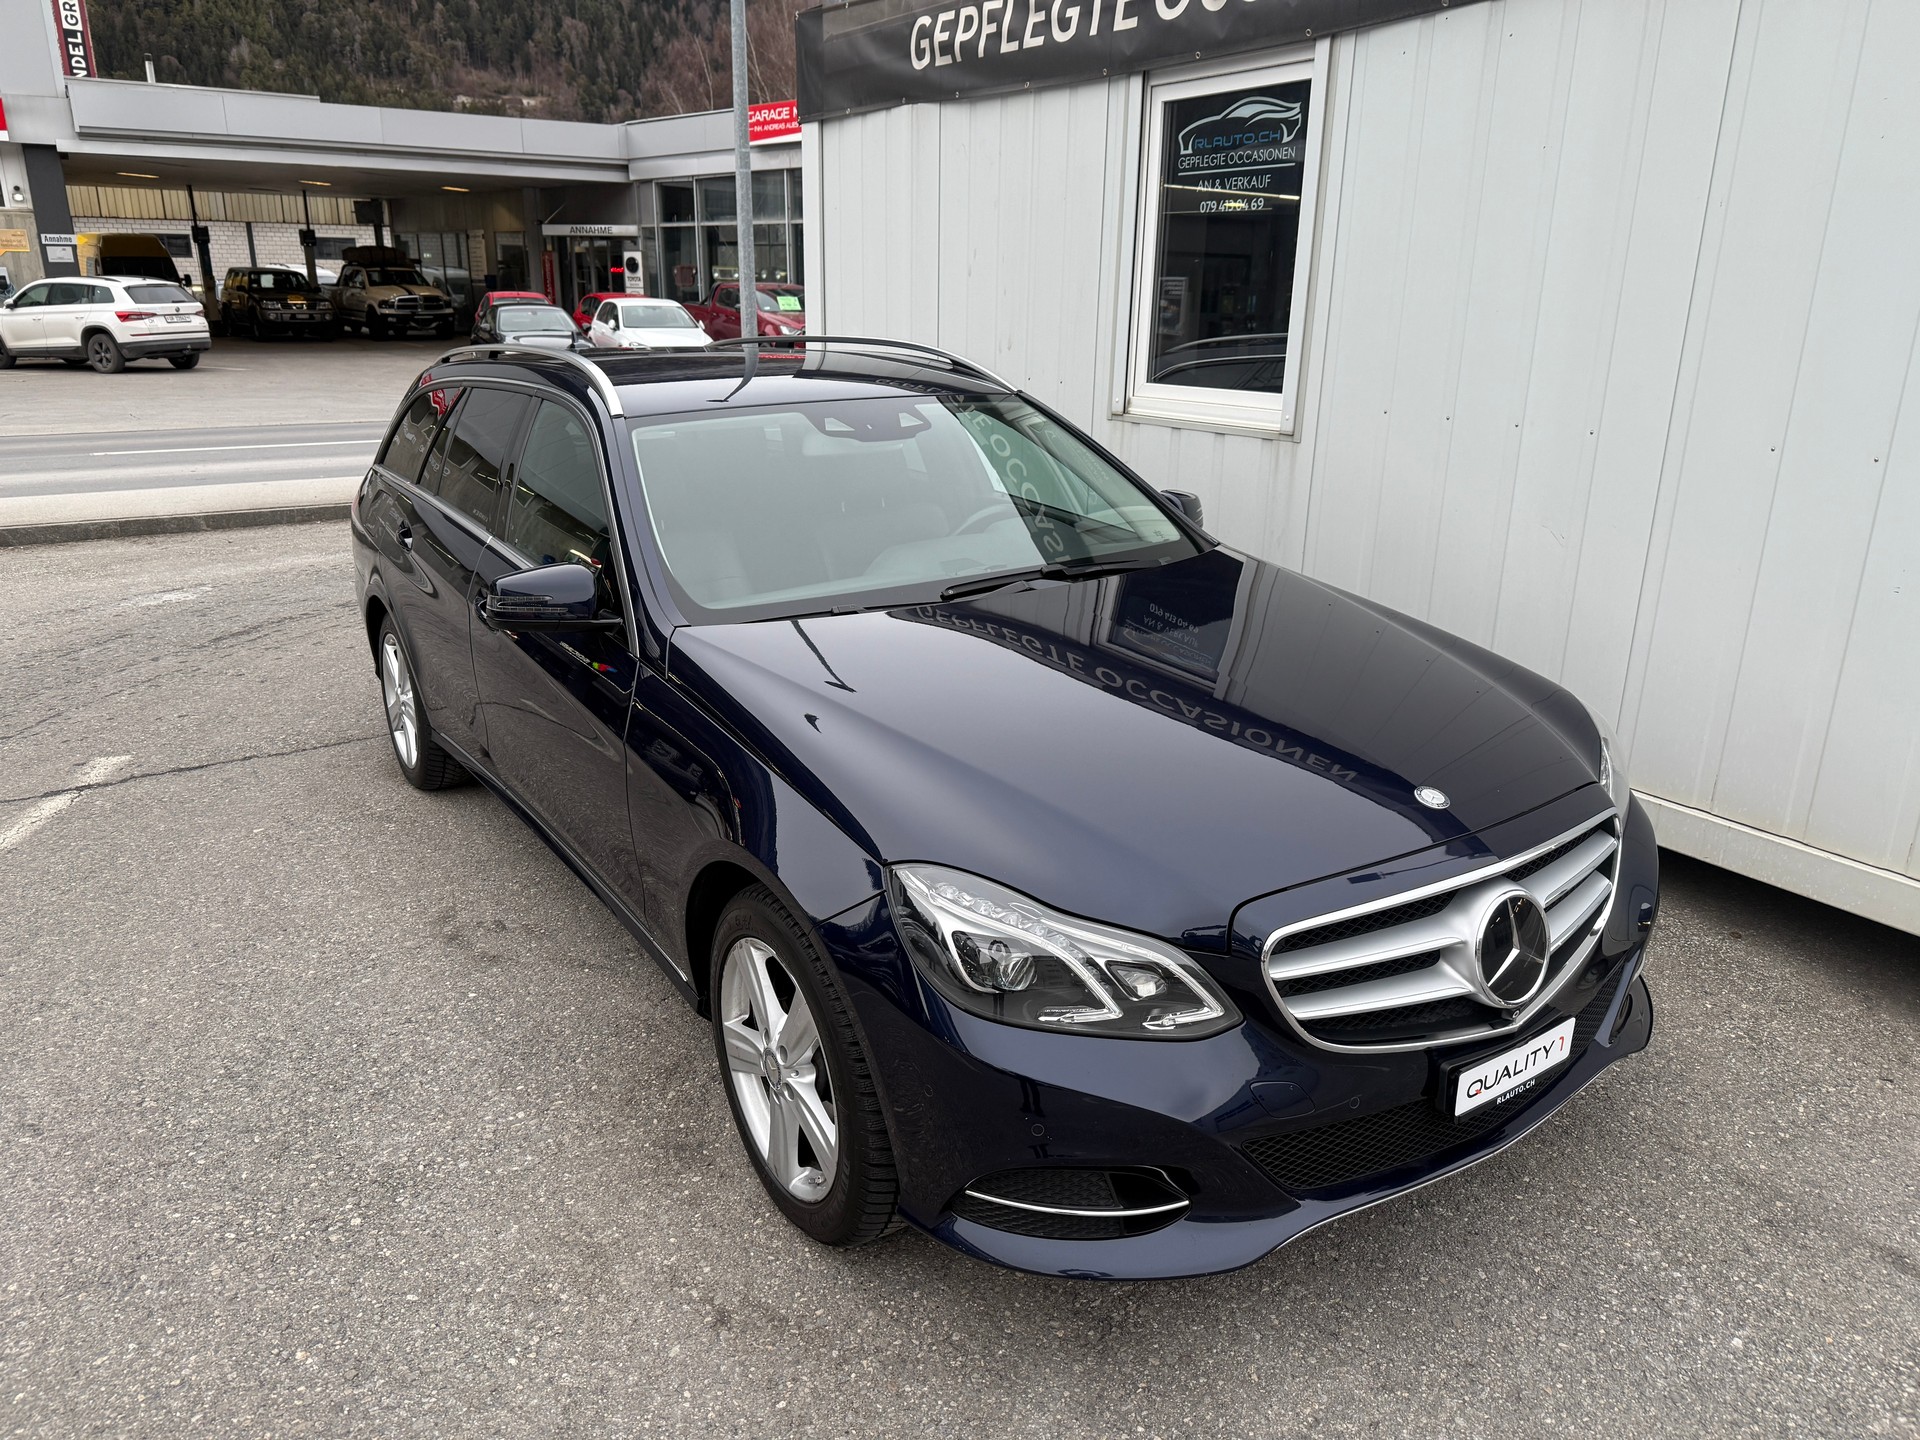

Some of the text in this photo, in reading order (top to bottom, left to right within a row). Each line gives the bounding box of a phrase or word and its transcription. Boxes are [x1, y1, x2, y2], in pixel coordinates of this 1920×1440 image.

[748, 107, 790, 122] GARAGE
[1194, 130, 1281, 149] RLAUTO.CH
[1178, 146, 1296, 169] GEPFLEGTE OCCASIONEN
[1196, 174, 1272, 192] AN & VERKAUF
[1200, 200, 1216, 214] 079
[1250, 197, 1264, 210] 69
[44, 235, 73, 243] Annahme
[569, 226, 613, 235] ANNAHME
[1466, 1036, 1565, 1099] QUALITY 1
[1496, 1078, 1536, 1105] RLAUTO.CH
